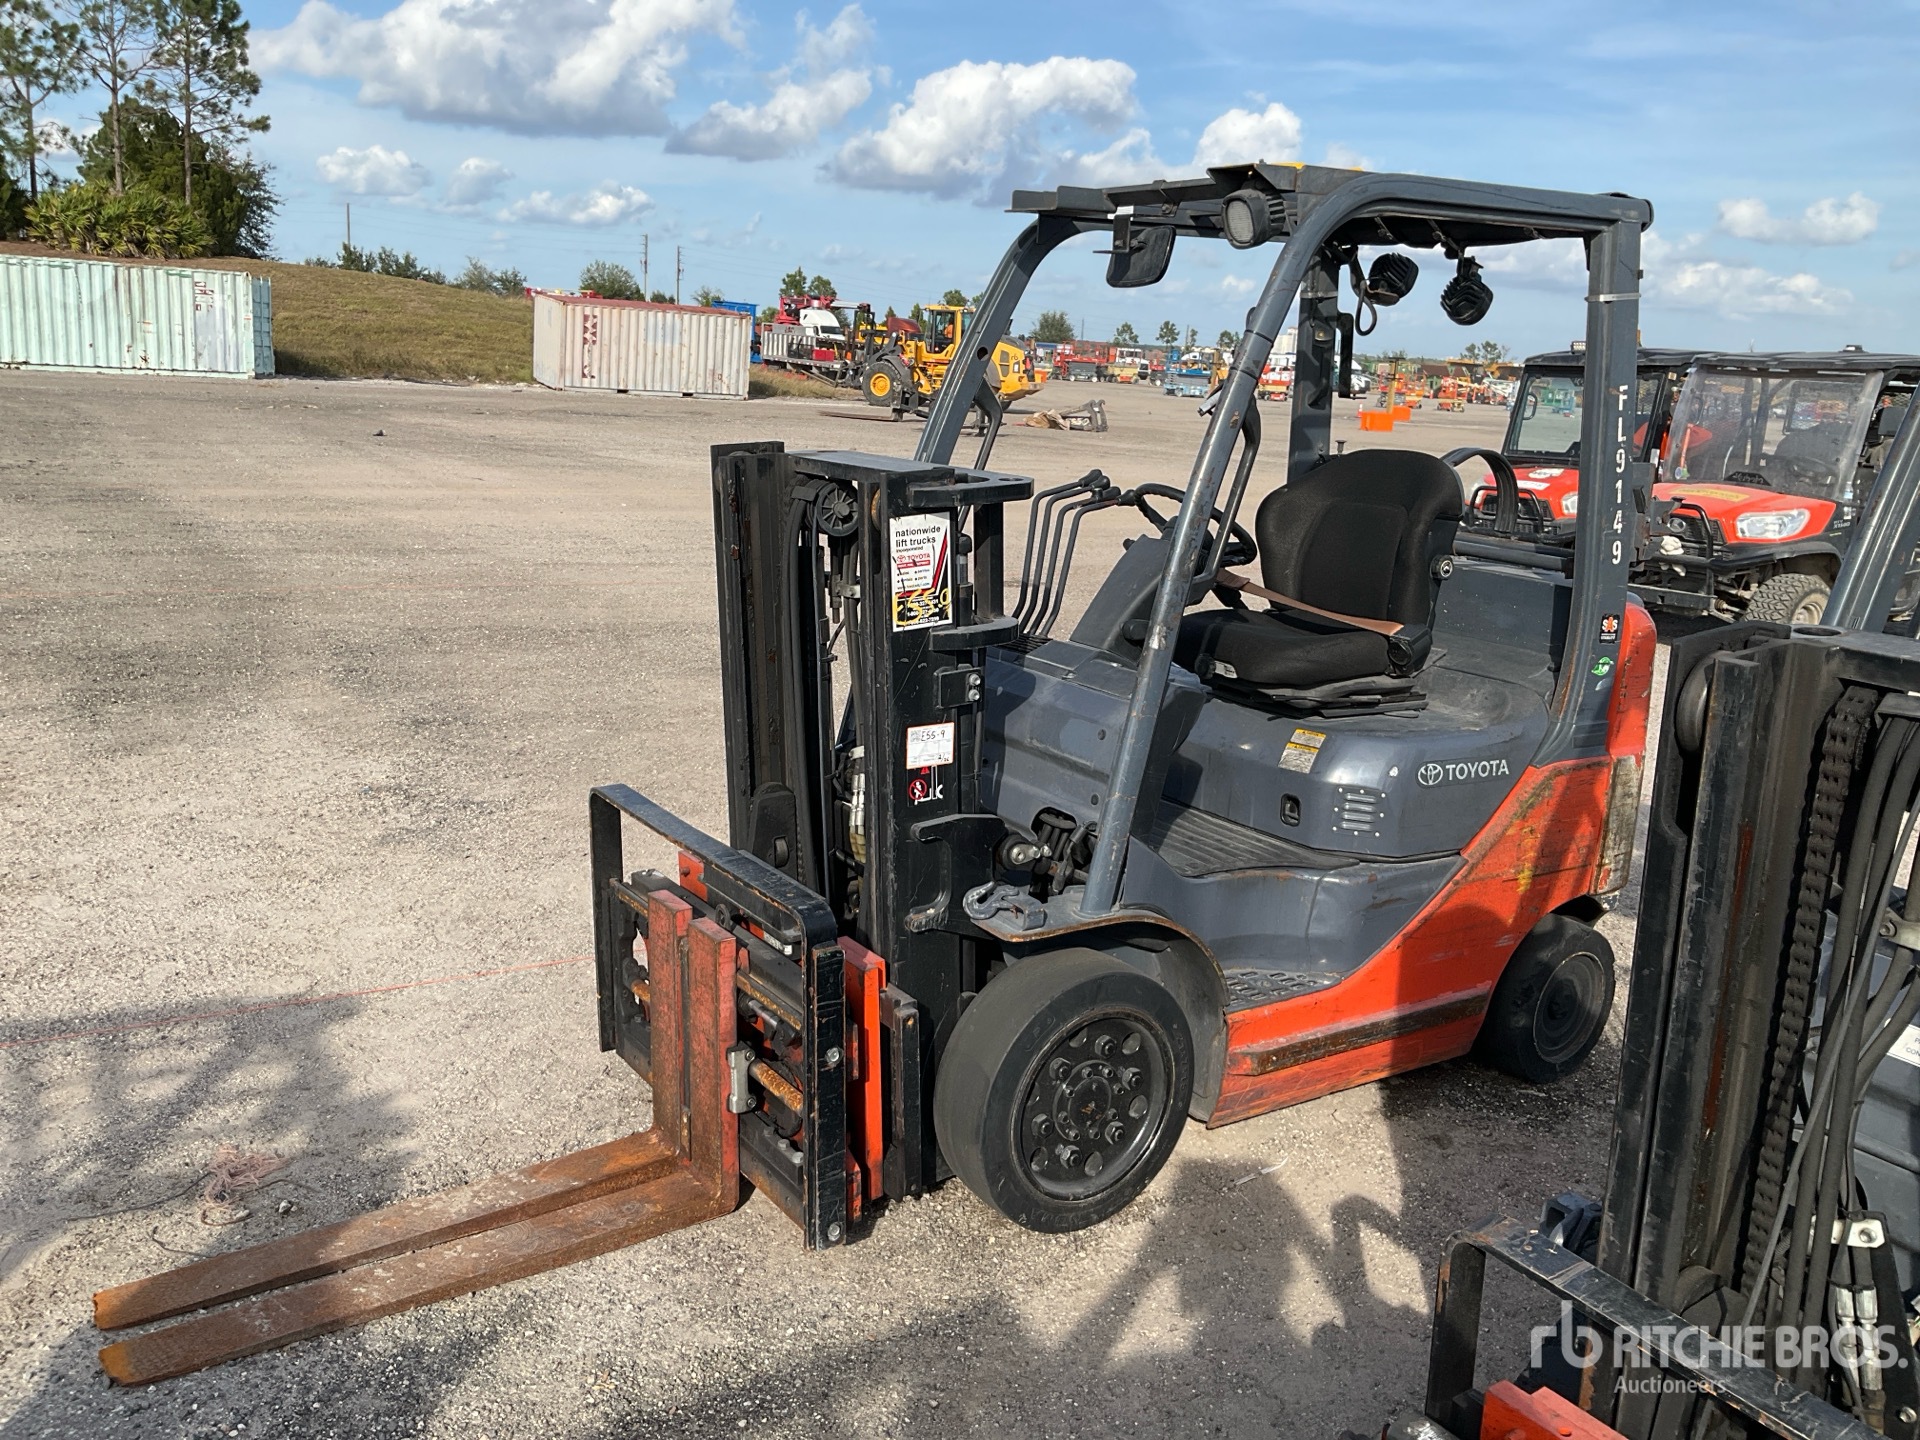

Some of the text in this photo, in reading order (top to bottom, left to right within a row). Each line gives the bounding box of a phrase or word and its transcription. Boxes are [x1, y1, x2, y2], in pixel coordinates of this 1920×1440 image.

[1611, 385, 1629, 565] FL9149
[895, 525, 941, 537] nationwide
[895, 535, 937, 548] lift trucks
[907, 553, 931, 561] TOYOTA
[1601, 616, 1619, 632] SAS
[1445, 758, 1510, 782] TOYOTA
